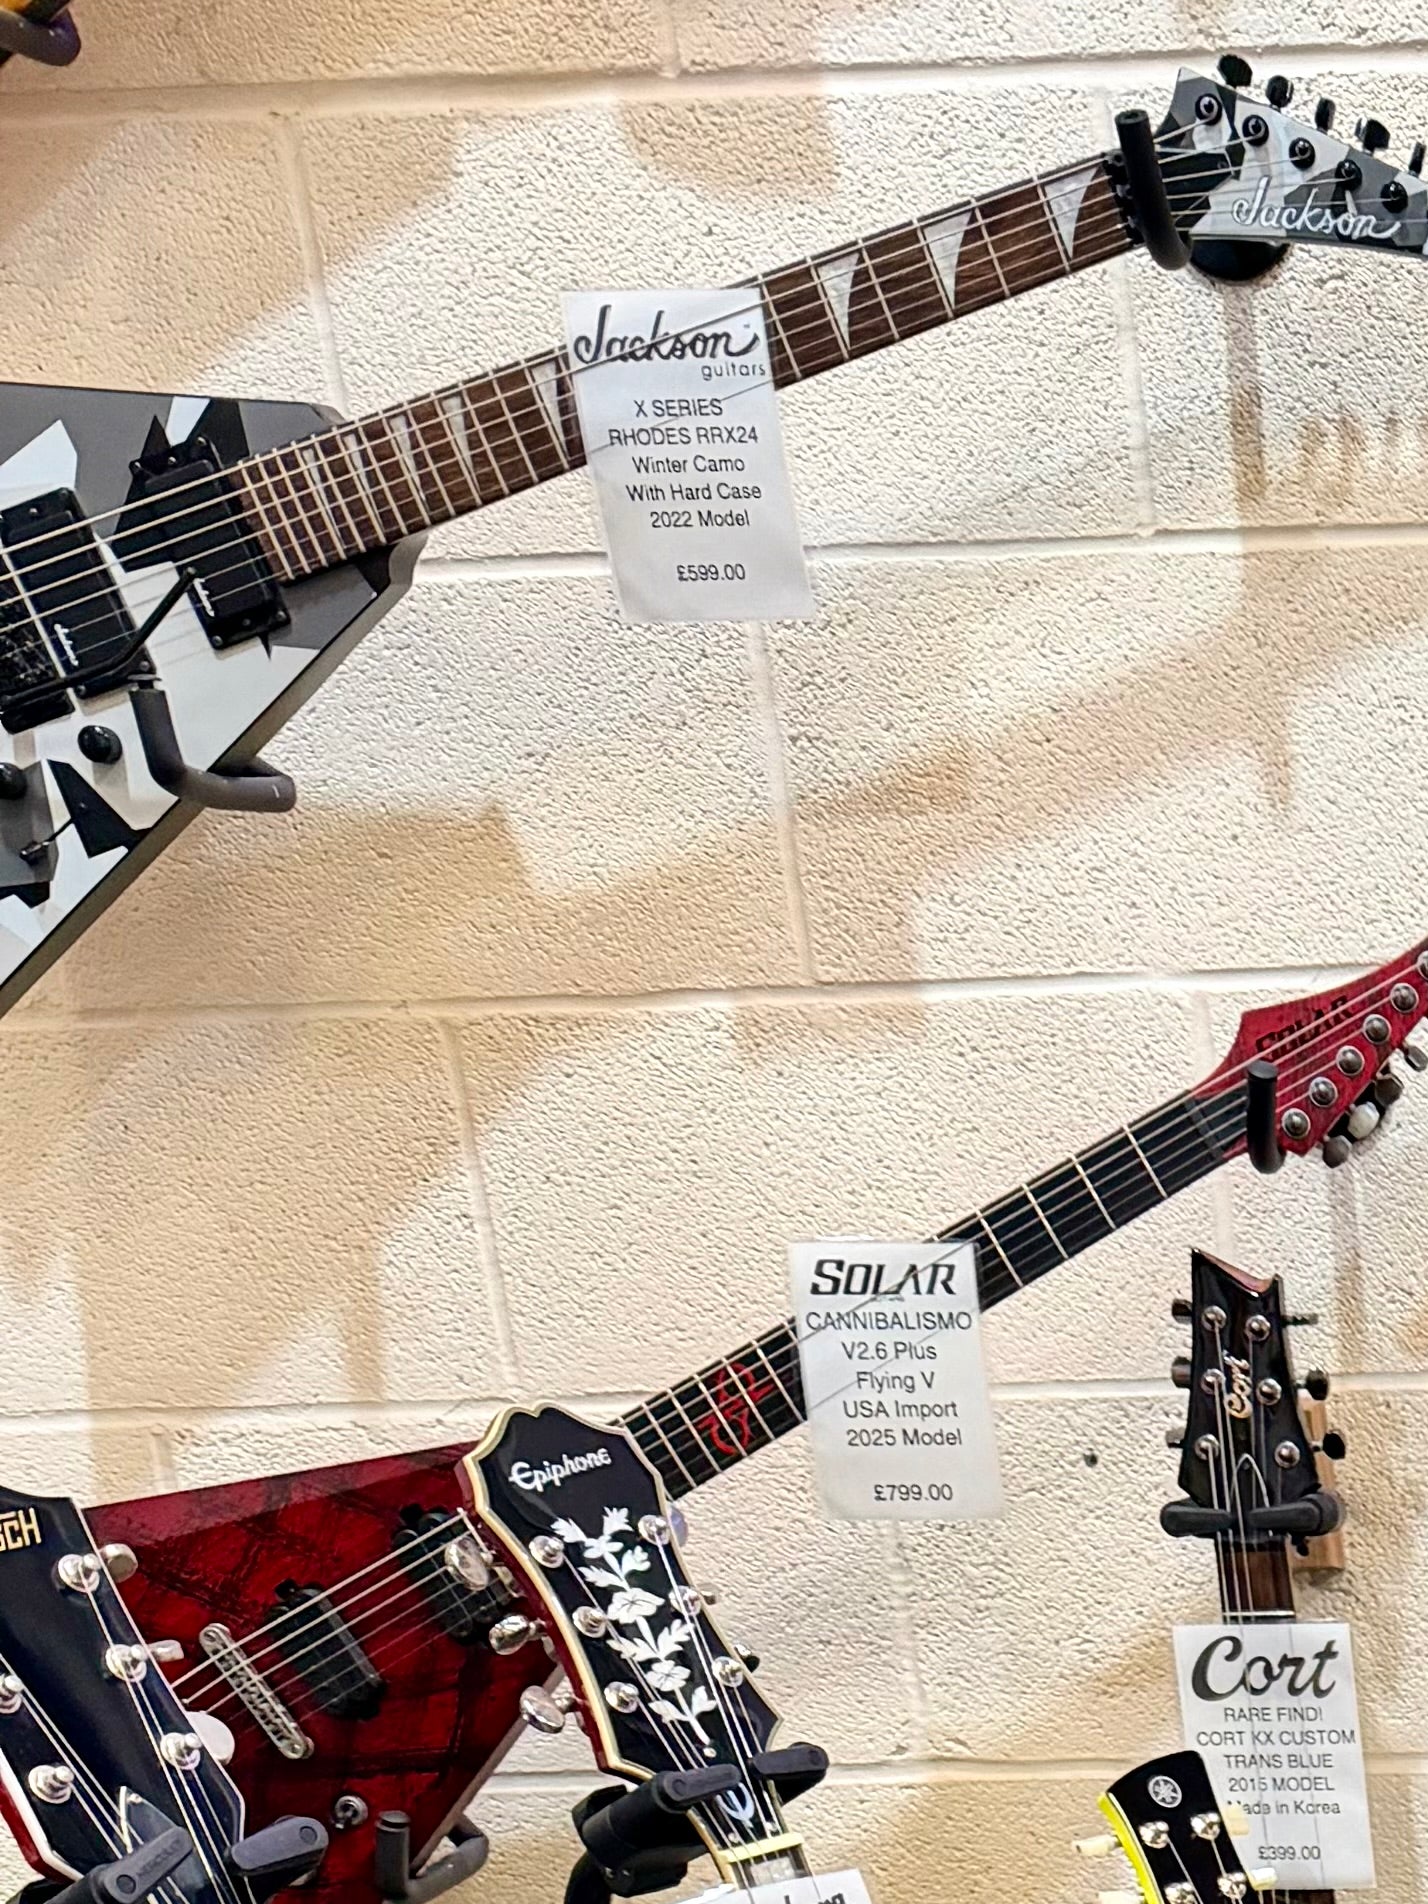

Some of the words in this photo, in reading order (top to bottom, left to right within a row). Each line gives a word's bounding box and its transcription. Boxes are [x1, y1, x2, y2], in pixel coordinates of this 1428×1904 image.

[1232, 177, 1401, 240] Jackson
[573, 304, 761, 365] Jackson
[701, 365, 766, 381] guitars
[635, 401, 647, 418] X
[653, 399, 723, 417] SERIES
[608, 428, 692, 446] RHODES
[697, 426, 758, 444] RRX24
[632, 456, 688, 473] Winter
[694, 456, 745, 473] Camo
[626, 485, 665, 502] With
[671, 485, 712, 500] Hard
[717, 484, 762, 500] Case
[650, 512, 692, 528] 2022
[699, 511, 750, 528] Model
[677, 564, 746, 581] £599.00
[810, 1259, 956, 1295] SOLAR
[806, 1312, 972, 1330] CANNIBALISMO
[841, 1342, 888, 1360] V2.6
[894, 1342, 937, 1360] Plus
[856, 1371, 915, 1393] Flying
[921, 1372, 935, 1388] V
[843, 1401, 889, 1418] USA
[895, 1401, 958, 1420] Import
[847, 1429, 896, 1446] 2025
[902, 1429, 962, 1446] Model
[507, 1446, 612, 1492] Epiphone
[874, 1484, 952, 1500] £799.00
[1192, 1636, 1339, 1701] Cort
[1224, 1707, 1272, 1722] RARE
[1196, 1731, 1245, 1746] CORT
[1252, 1731, 1274, 1745] KX
[1279, 1730, 1356, 1745] CUSTOM
[1224, 1755, 1283, 1768] TRANS
[1287, 1754, 1333, 1768] BLUE
[1228, 1778, 1267, 1792] 2015
[1272, 1777, 1335, 1791] MODEL
[1276, 1802, 1289, 1814] in
[1293, 1801, 1340, 1814] Korea
[1258, 1847, 1321, 1860] £399.00
